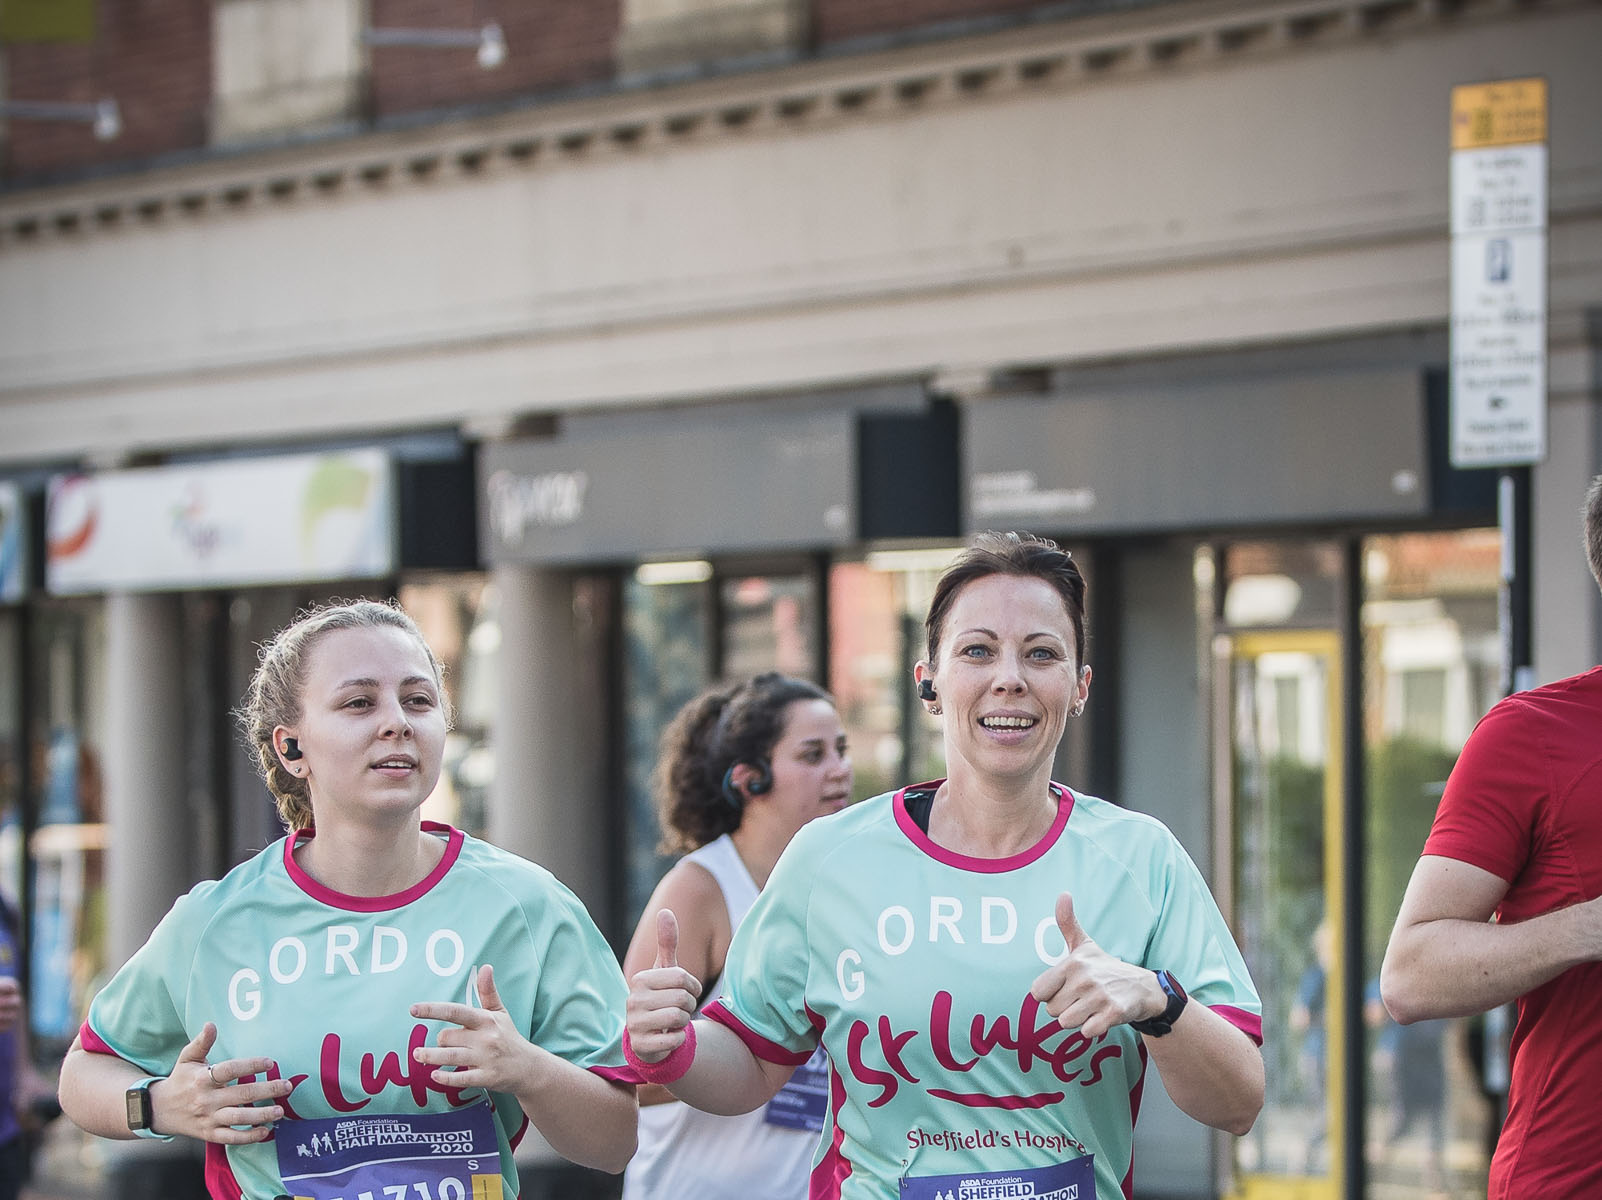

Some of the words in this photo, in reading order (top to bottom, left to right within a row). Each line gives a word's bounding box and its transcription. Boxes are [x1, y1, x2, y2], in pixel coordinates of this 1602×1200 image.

[836, 896, 1068, 1002] GORDO
[847, 1015, 920, 1108] St
[336, 1120, 357, 1129] ASDA
[336, 1124, 410, 1140] SHEFFIELD
[338, 1137, 379, 1151] HALF
[379, 1131, 472, 1145] MARATHON
[906, 1128, 1011, 1151] Sheffield's
[431, 1144, 474, 1154] 2020
[467, 1160, 480, 1171] S
[960, 1178, 981, 1187] ASDA
[981, 1176, 1022, 1186] Foundation
[960, 1183, 1033, 1200] SHEFFIELD
